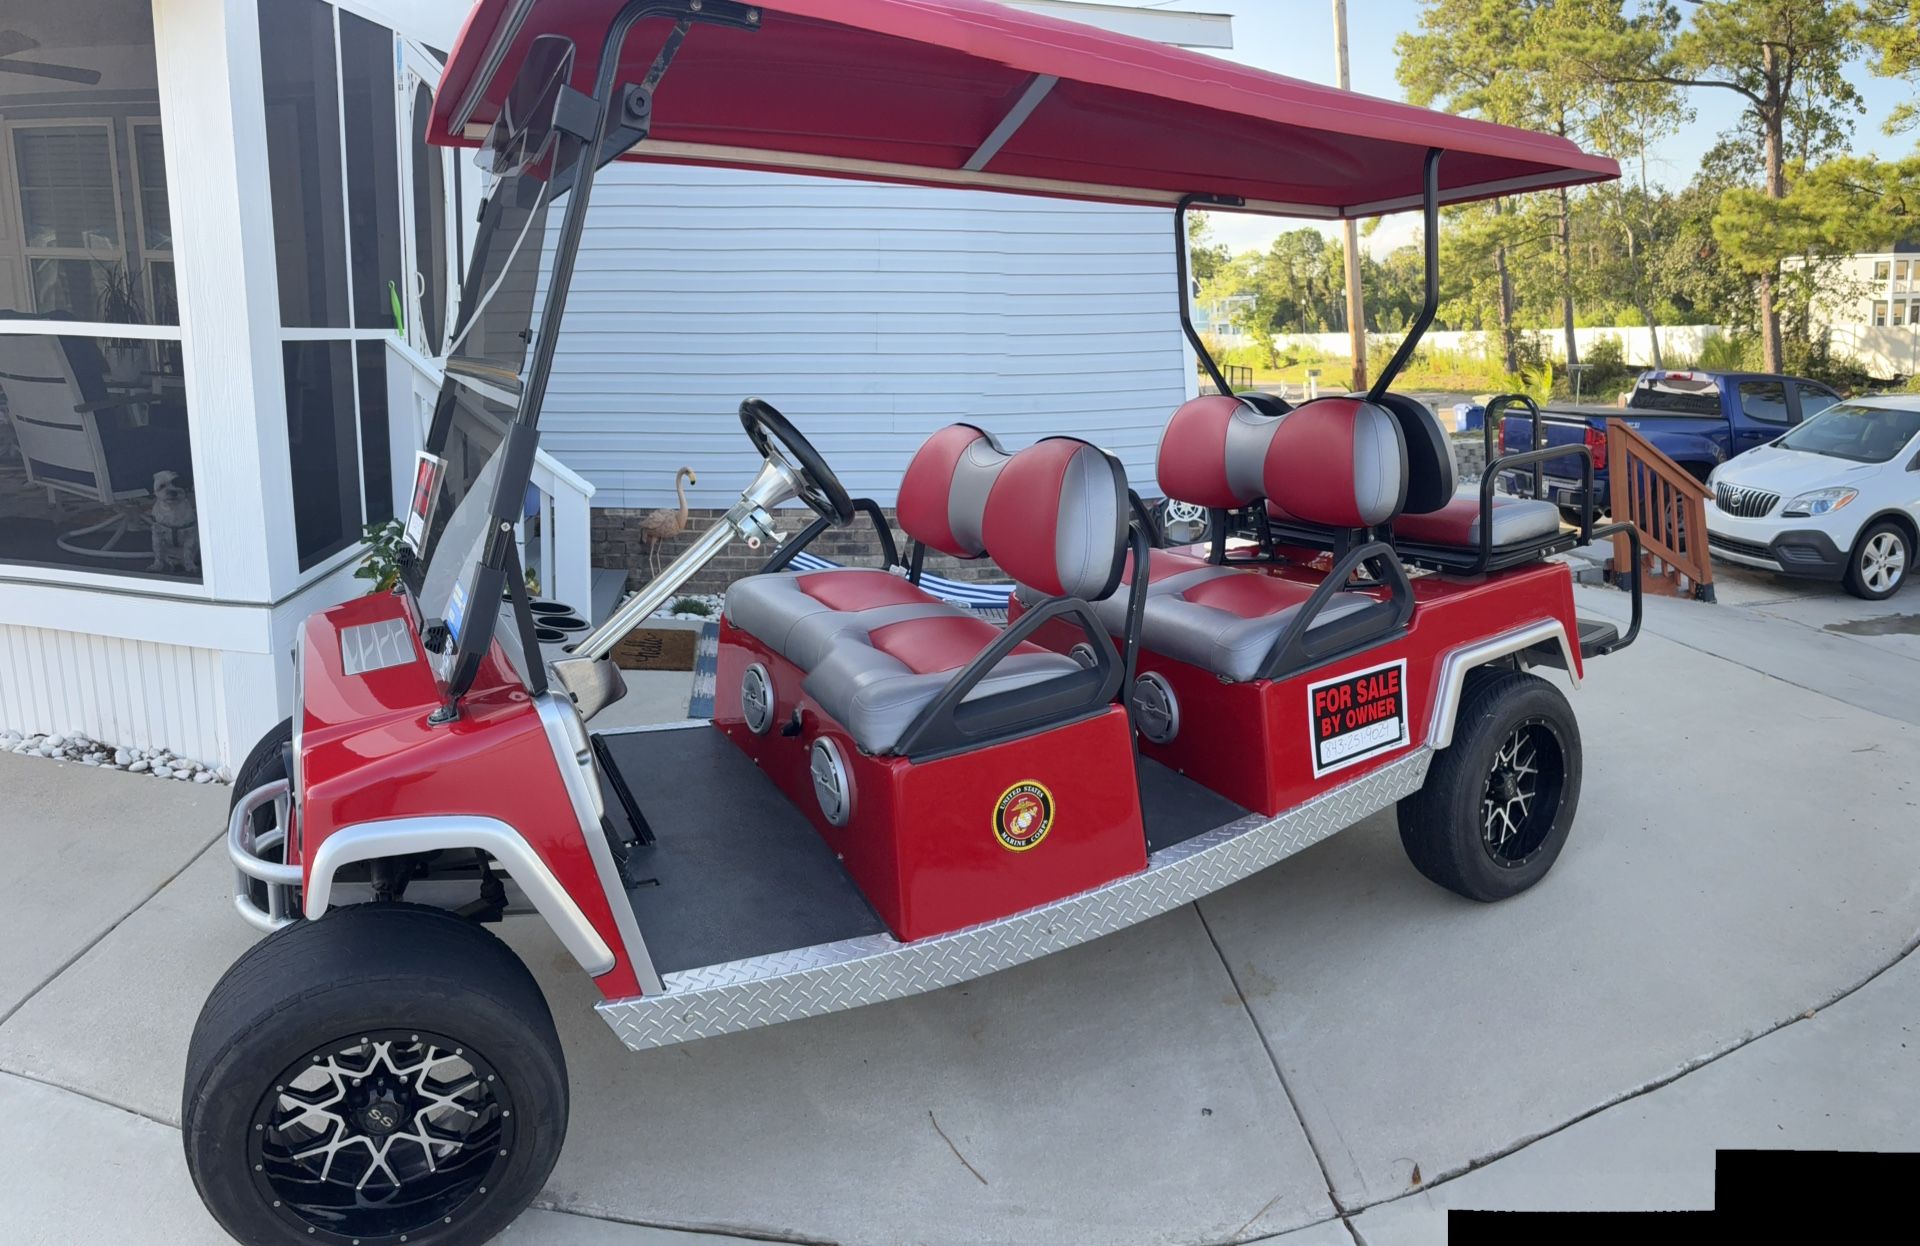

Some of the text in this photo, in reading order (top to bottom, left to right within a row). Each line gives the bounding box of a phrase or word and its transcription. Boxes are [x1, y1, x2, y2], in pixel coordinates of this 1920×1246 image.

[1315, 670, 1400, 717] FOR SALE
[1321, 697, 1396, 737] BY OWNER
[1000, 785, 1045, 810] UNITED STATES
[1001, 819, 1049, 846] MARINE CORPS
[367, 1108, 394, 1128] SS
